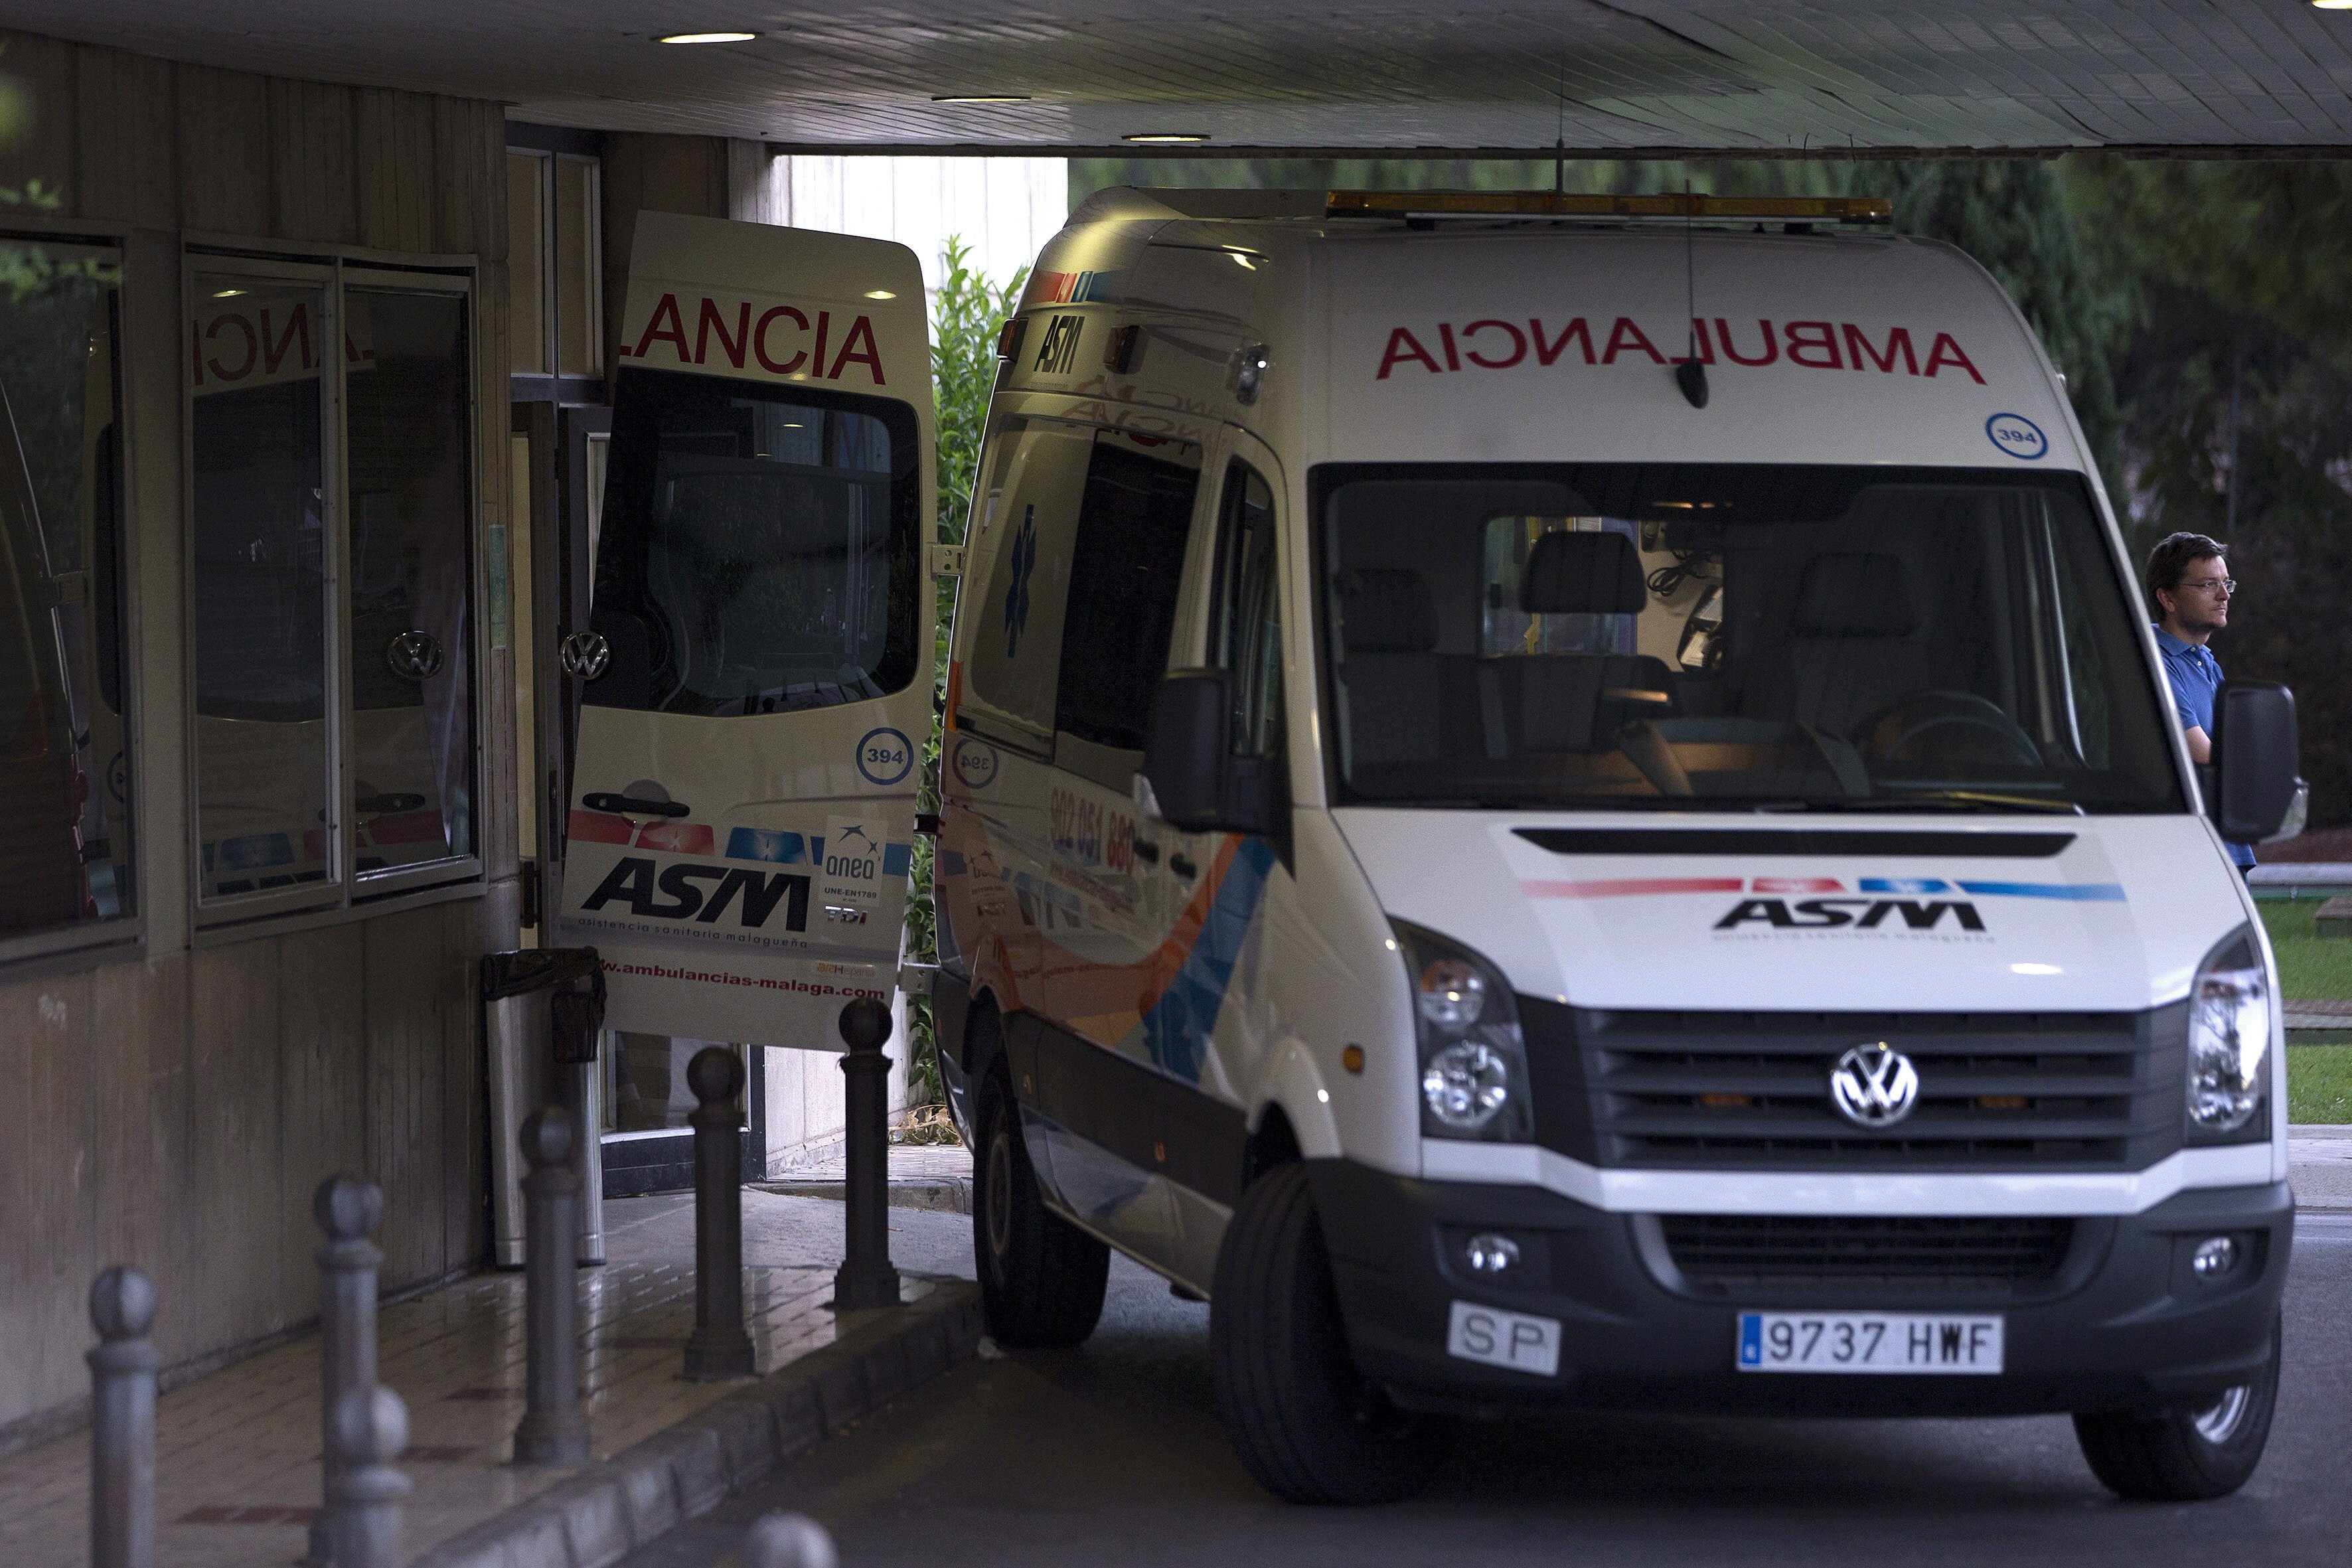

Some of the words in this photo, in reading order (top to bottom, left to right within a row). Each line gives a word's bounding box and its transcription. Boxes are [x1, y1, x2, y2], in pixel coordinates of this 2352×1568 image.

[619, 293, 886, 386] ANCIA
[1034, 315, 1085, 374] ASM
[1998, 427, 2037, 445] 394
[867, 748, 904, 765] 394
[580, 856, 811, 933] ASM
[824, 887, 877, 900] UNE-EN1789
[825, 905, 868, 925] TDI
[1713, 899, 1987, 931] ASM
[578, 917, 650, 933] asistencia
[655, 925, 720, 940] sanitaria
[726, 932, 808, 949] malagueña
[1768, 1319, 1887, 1362] 9737
[1908, 1321, 1993, 1364] HWF
